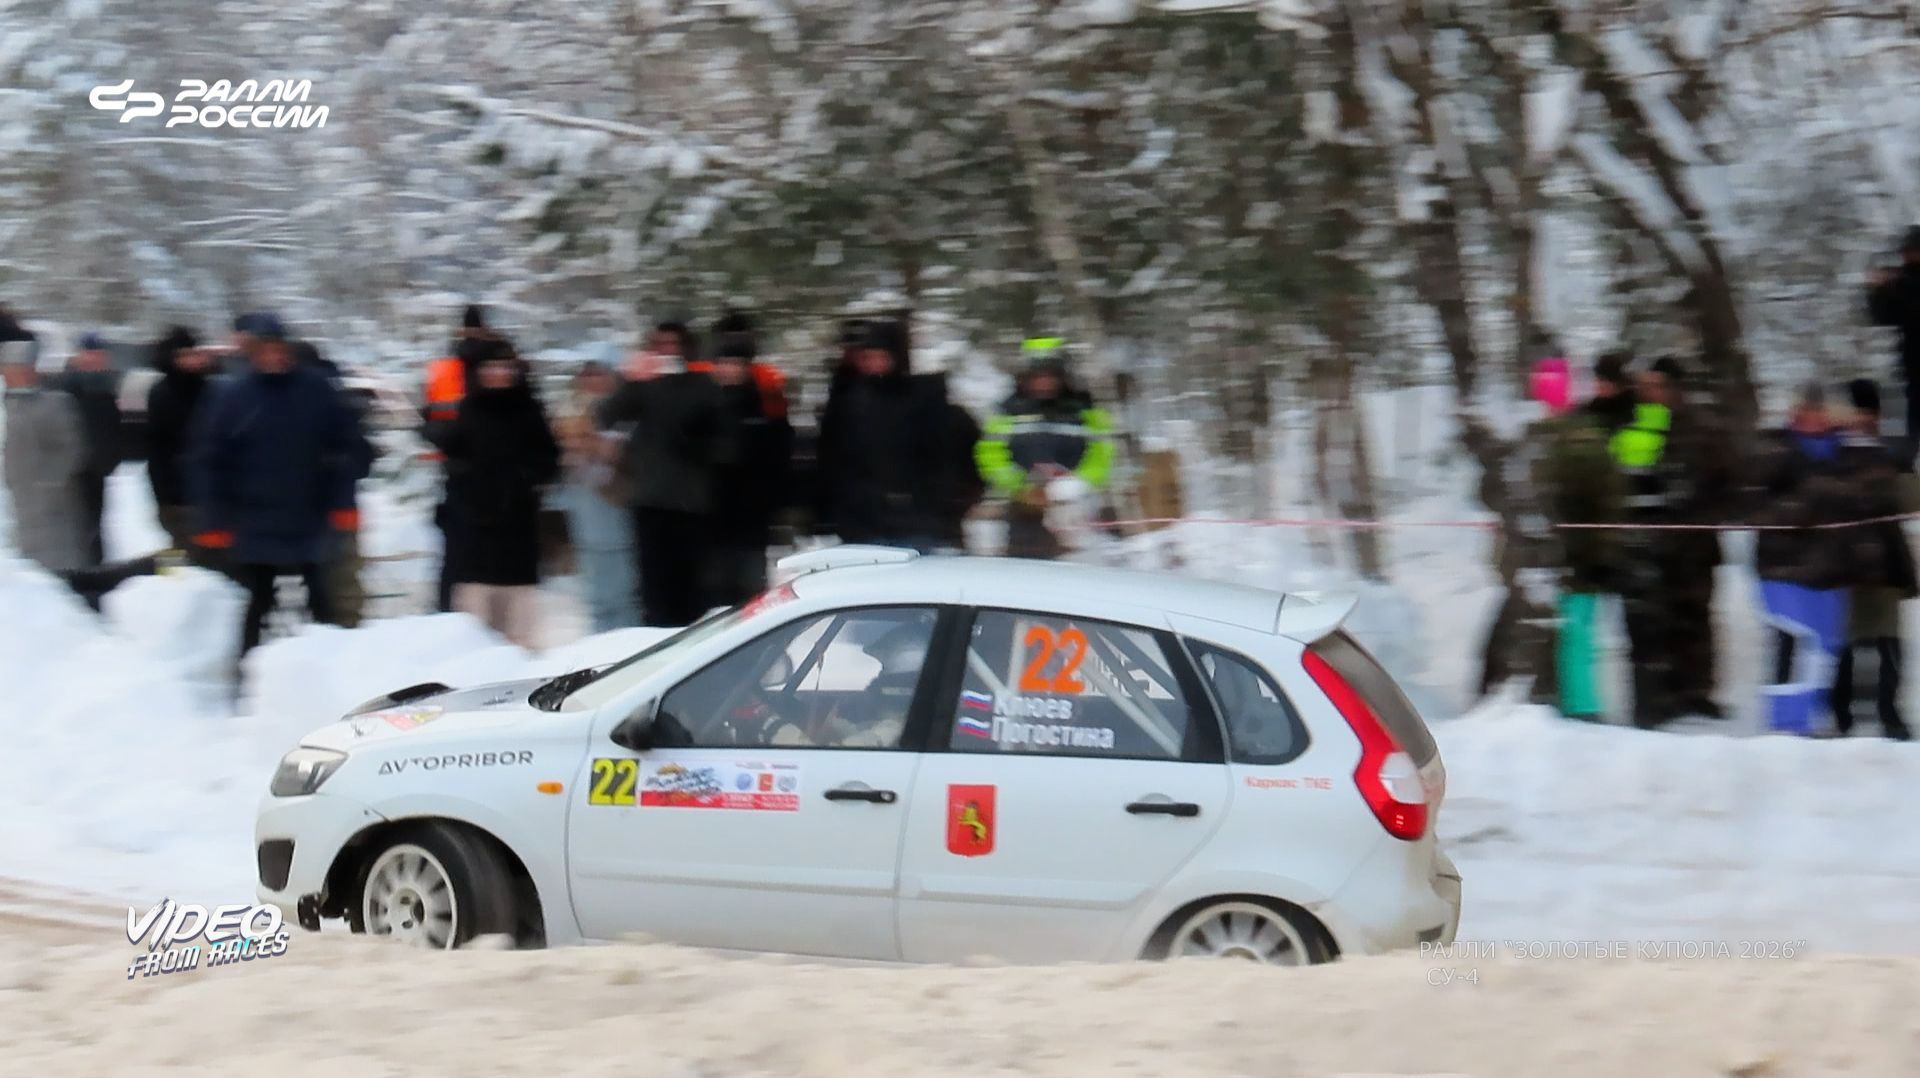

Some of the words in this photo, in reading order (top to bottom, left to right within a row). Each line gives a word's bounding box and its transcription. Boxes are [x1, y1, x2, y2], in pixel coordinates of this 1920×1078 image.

[1018, 625, 1088, 694] 22
[378, 749, 534, 776] AVTOPRIBOR
[590, 758, 638, 805] 22
